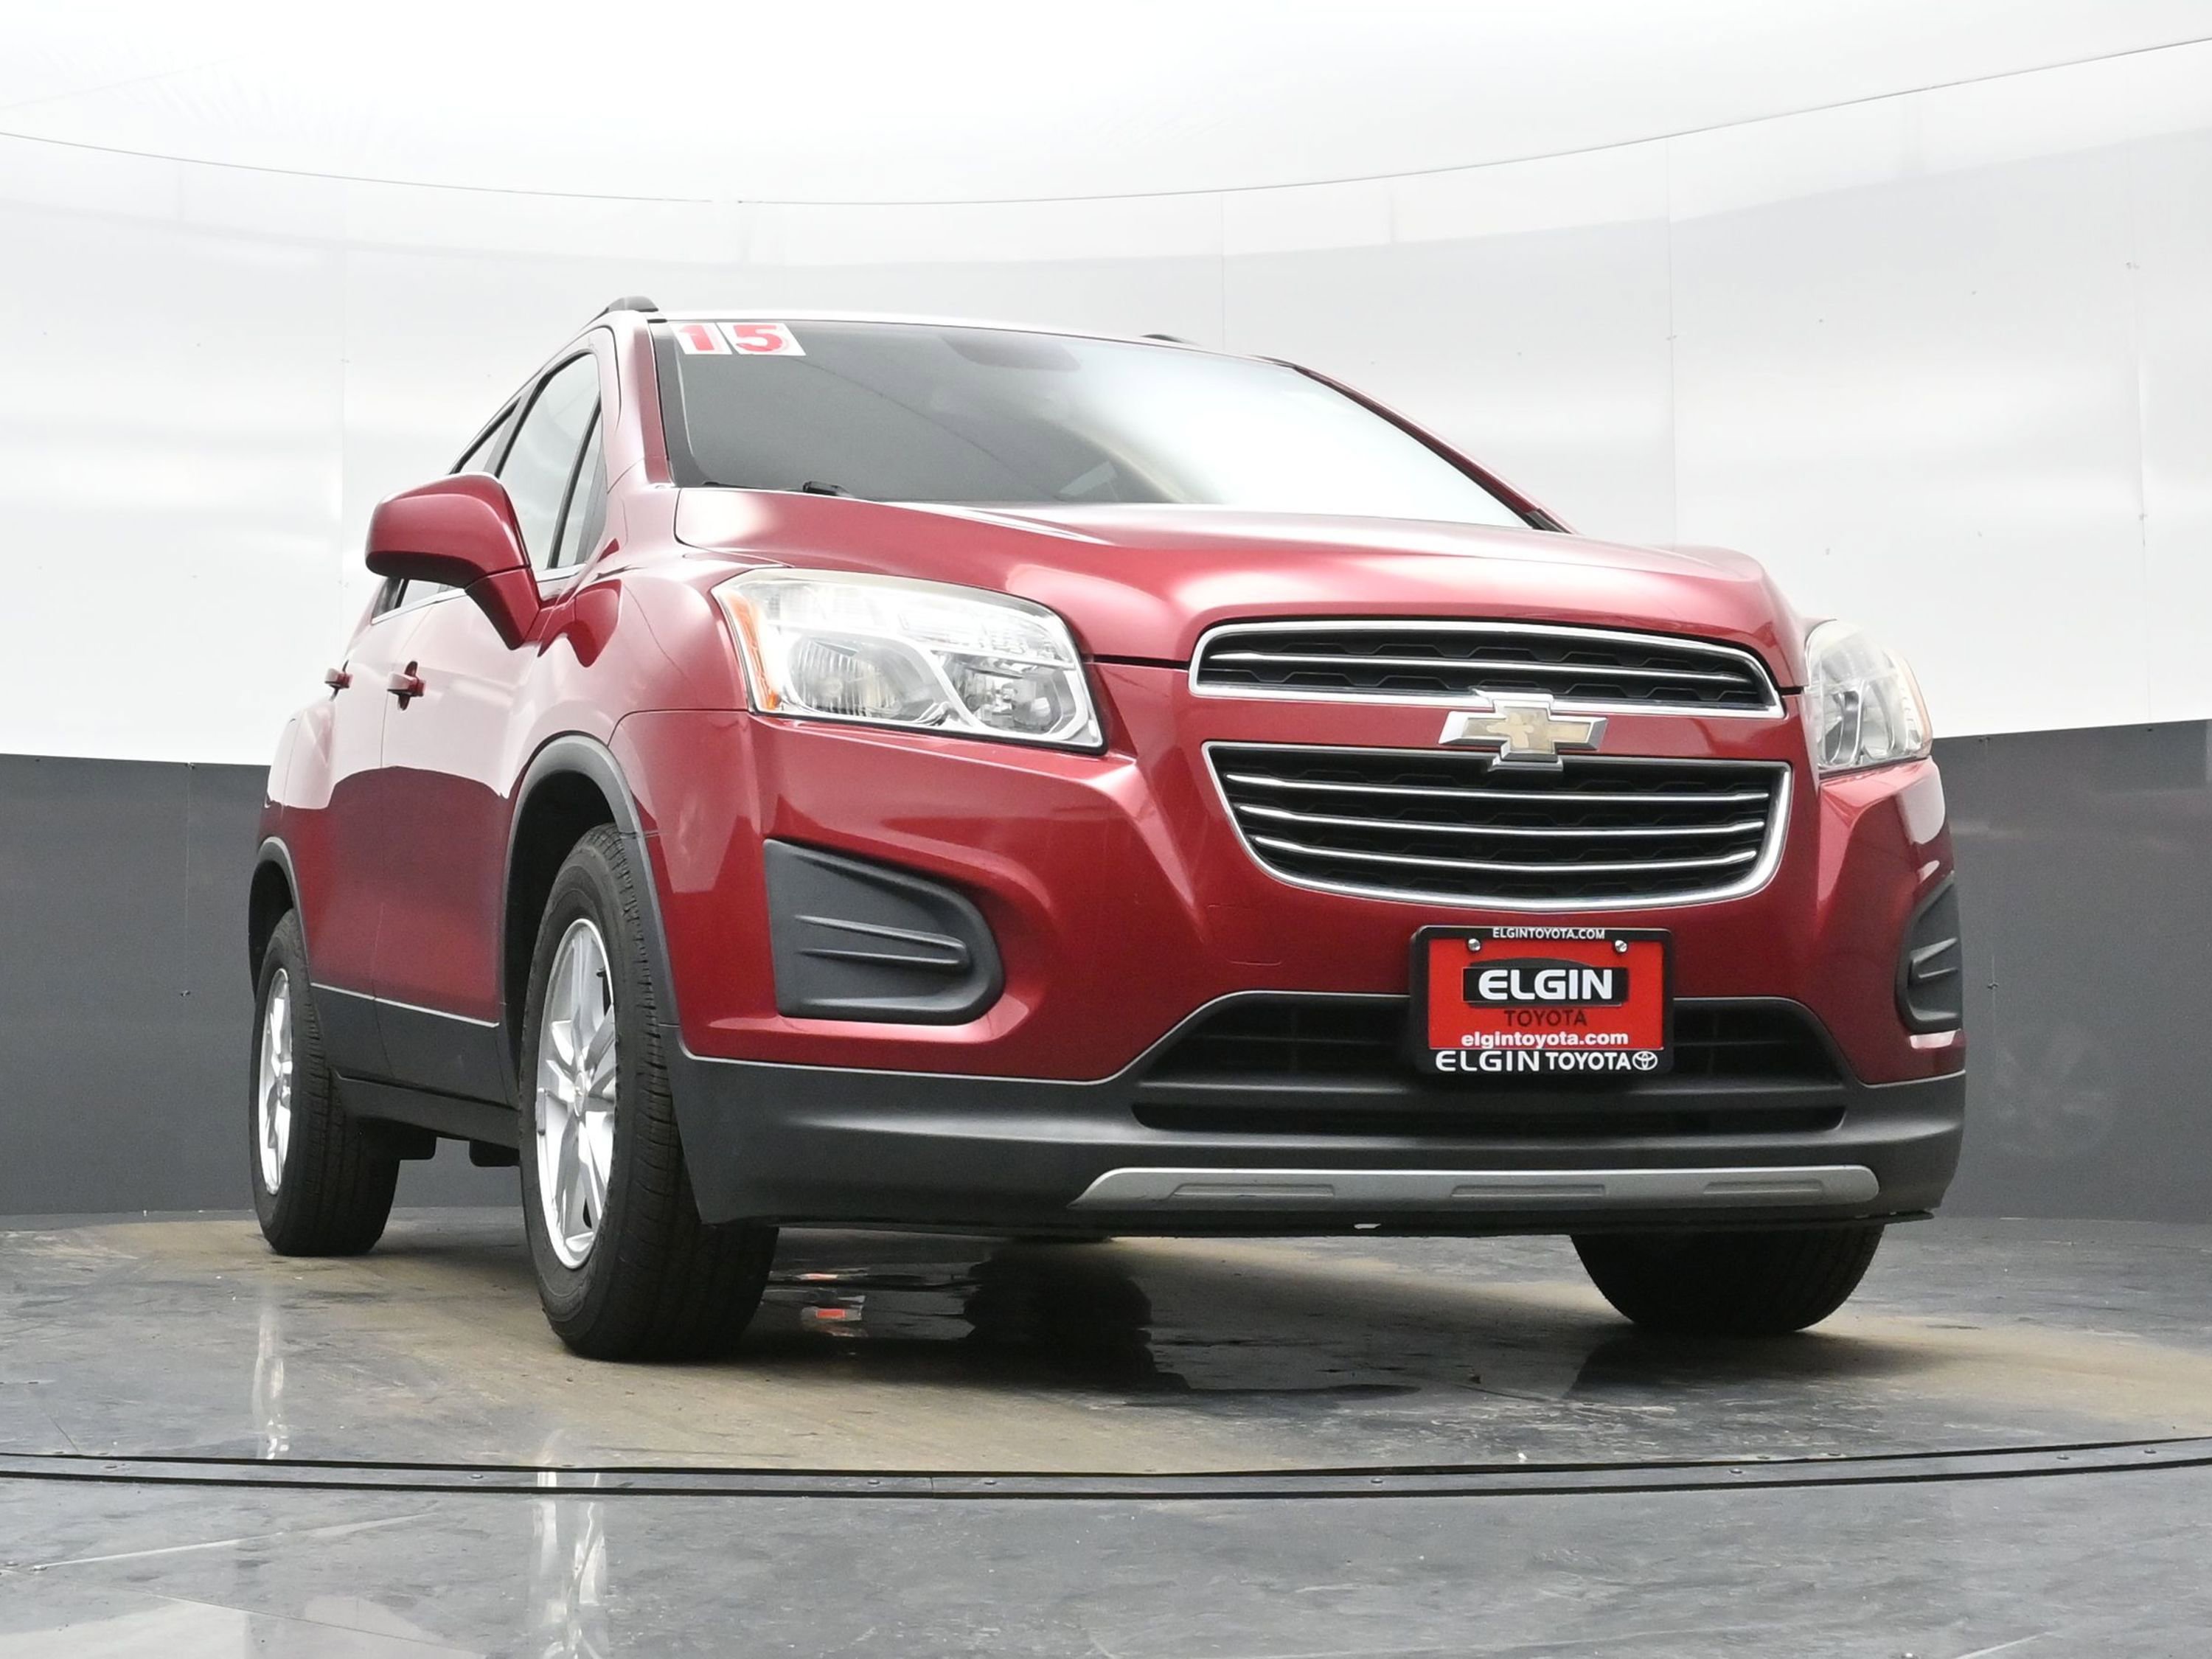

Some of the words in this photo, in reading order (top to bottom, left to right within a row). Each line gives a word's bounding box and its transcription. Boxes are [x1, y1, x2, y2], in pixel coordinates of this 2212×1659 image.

[679, 324, 784, 352] 15
[1492, 928, 1605, 940] ELGINTOYOTA.COM
[1478, 969, 1613, 1001] ELGIN
[1504, 1009, 1587, 1027] TOYOTA
[1461, 1031, 1629, 1049] elgintoyota.com
[1436, 1050, 1540, 1072] ELGIN
[1545, 1051, 1632, 1071] TOYOTA
